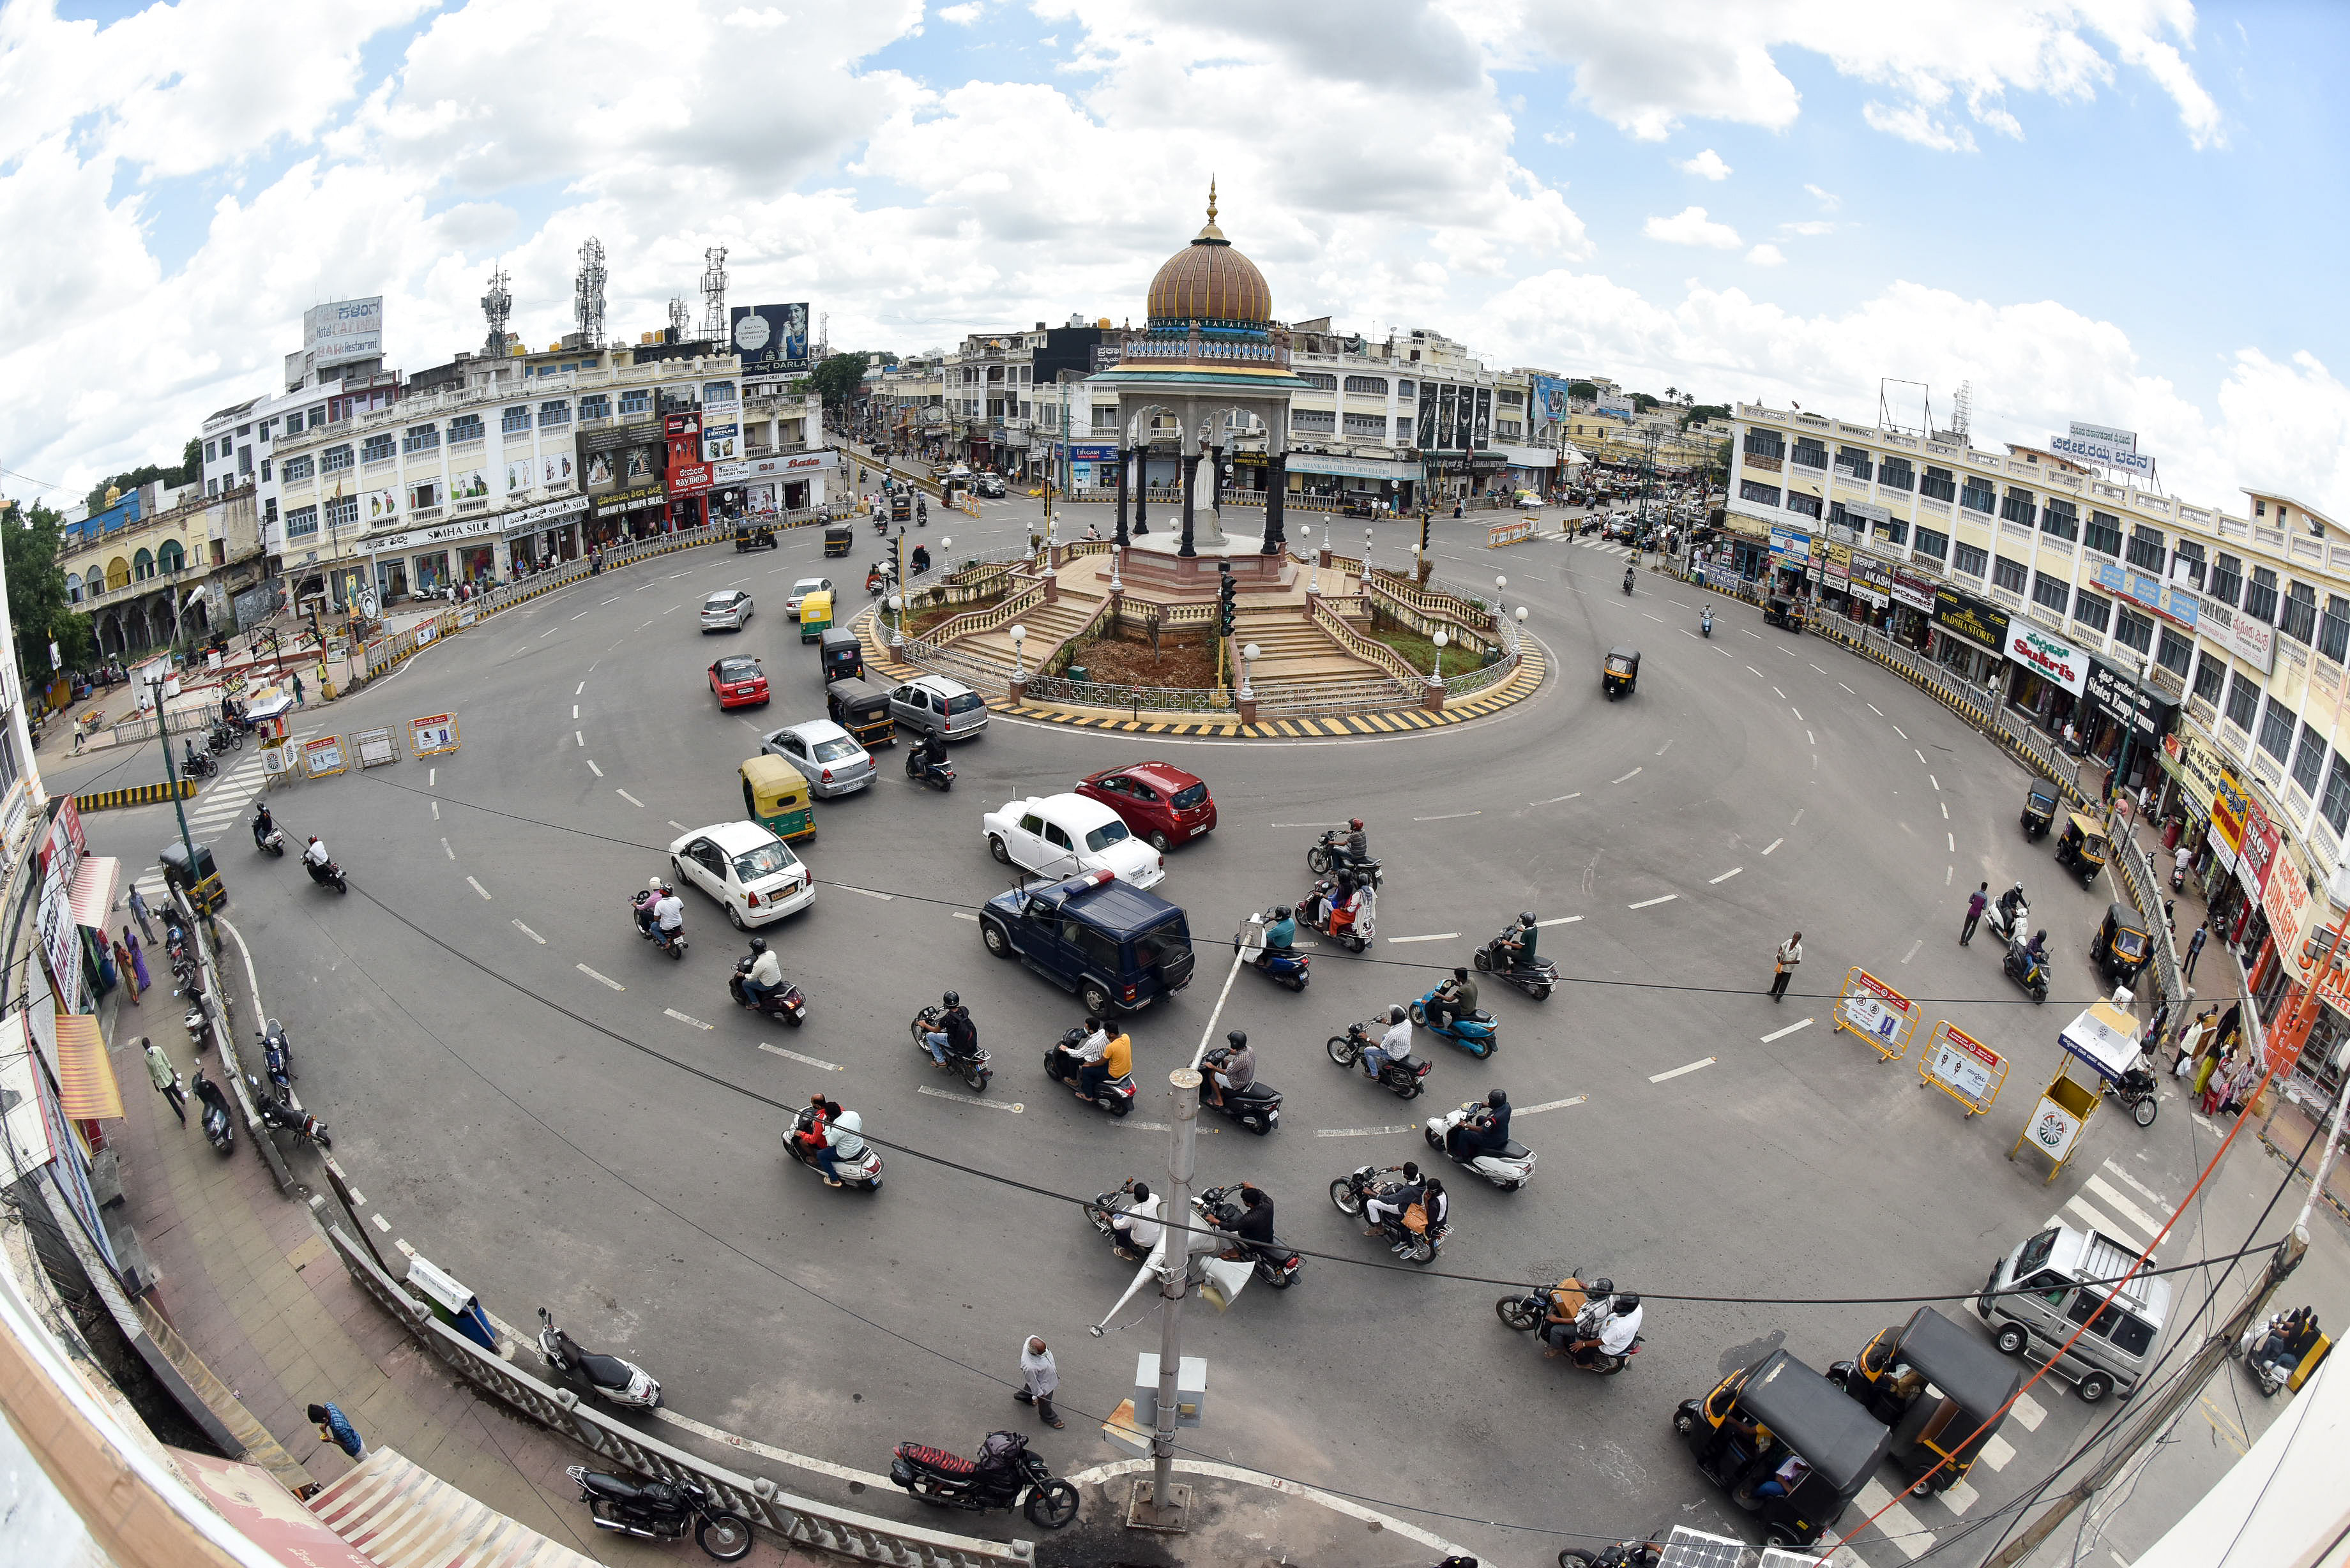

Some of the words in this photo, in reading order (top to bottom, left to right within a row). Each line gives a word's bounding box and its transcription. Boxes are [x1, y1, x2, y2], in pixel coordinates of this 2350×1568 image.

[317, 324, 331, 338] Hotel
[345, 338, 377, 353] Restaurant
[773, 361, 807, 369] DARLA
[787, 458, 821, 469] Bata
[2115, 449, 2148, 469] ಭವನ
[1356, 467, 1390, 475] JEWELLERS
[2107, 463, 2139, 474] BUILDING
[548, 502, 571, 515] SIMHA
[572, 499, 587, 508] SILK
[598, 502, 626, 516] BHOJAYYA
[628, 498, 647, 510] SHILPA
[648, 495, 663, 505] SILKS
[539, 518, 561, 530] SIMHA
[563, 515, 576, 524] SILK
[428, 525, 463, 541] SIMHA
[467, 520, 489, 532] SILK
[1784, 550, 1805, 560] SUPERTEX
[1789, 563, 1804, 571] CENTRE
[1717, 574, 1737, 585] PALACE
[1828, 575, 1845, 584] SAREES
[1830, 581, 1846, 590] CENTRE
[1850, 577, 1870, 587] MATCHING
[1874, 585, 1890, 594] CENTRE
[1865, 570, 1891, 588] AKASH
[1851, 589, 1872, 601] MATCHING
[2199, 597, 2210, 616] STAR
[2210, 600, 2215, 617] OF
[2215, 604, 2232, 628] MYSORE
[1941, 612, 1967, 631] BADSHA
[1967, 625, 1996, 644] STORES
[2028, 660, 2036, 669] Silk
[2037, 665, 2061, 682] Emporium
[2087, 677, 2111, 703] States
[2246, 820, 2270, 864] SHOE
[2244, 838, 2262, 874] MUSEUM
[2267, 872, 2300, 951] SUNLIGHT
